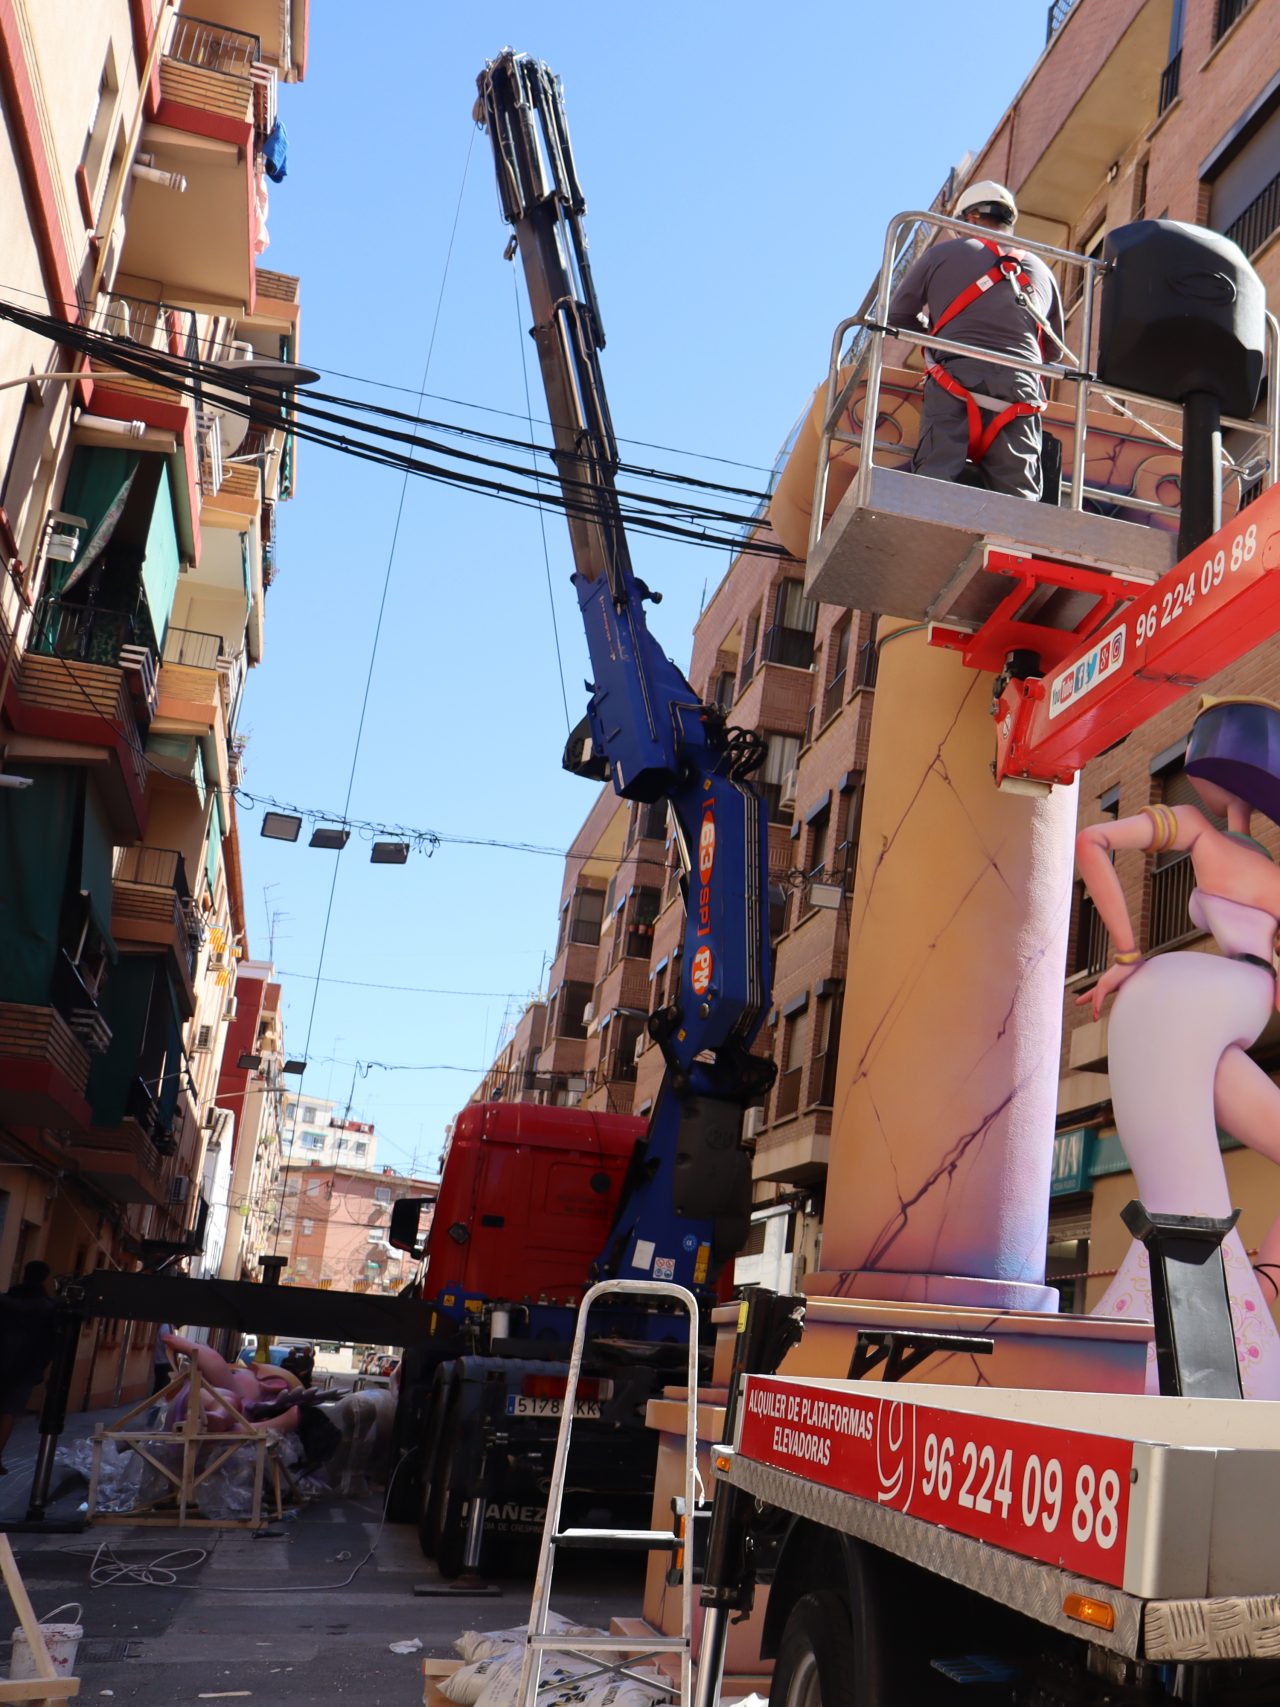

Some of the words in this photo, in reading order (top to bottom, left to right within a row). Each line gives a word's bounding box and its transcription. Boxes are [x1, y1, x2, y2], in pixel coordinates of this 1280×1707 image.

[1135, 605, 1157, 648] 96
[1161, 571, 1196, 627] 224
[1200, 550, 1226, 595] 09
[1230, 524, 1257, 571] 88
[694, 949, 711, 989] PM
[518, 1398, 560, 1414] 5178
[748, 1388, 787, 1420] ALQUILER
[787, 1396, 800, 1422] DE
[801, 1398, 875, 1441] PLATAFORMAS
[772, 1426, 831, 1467] ELEVADORAS
[461, 1500, 546, 1523] IAÑEZ
[922, 1433, 954, 1502] 96
[958, 1441, 1014, 1520] 224
[1020, 1458, 1064, 1533] 09
[1071, 1464, 1121, 1551] 88
